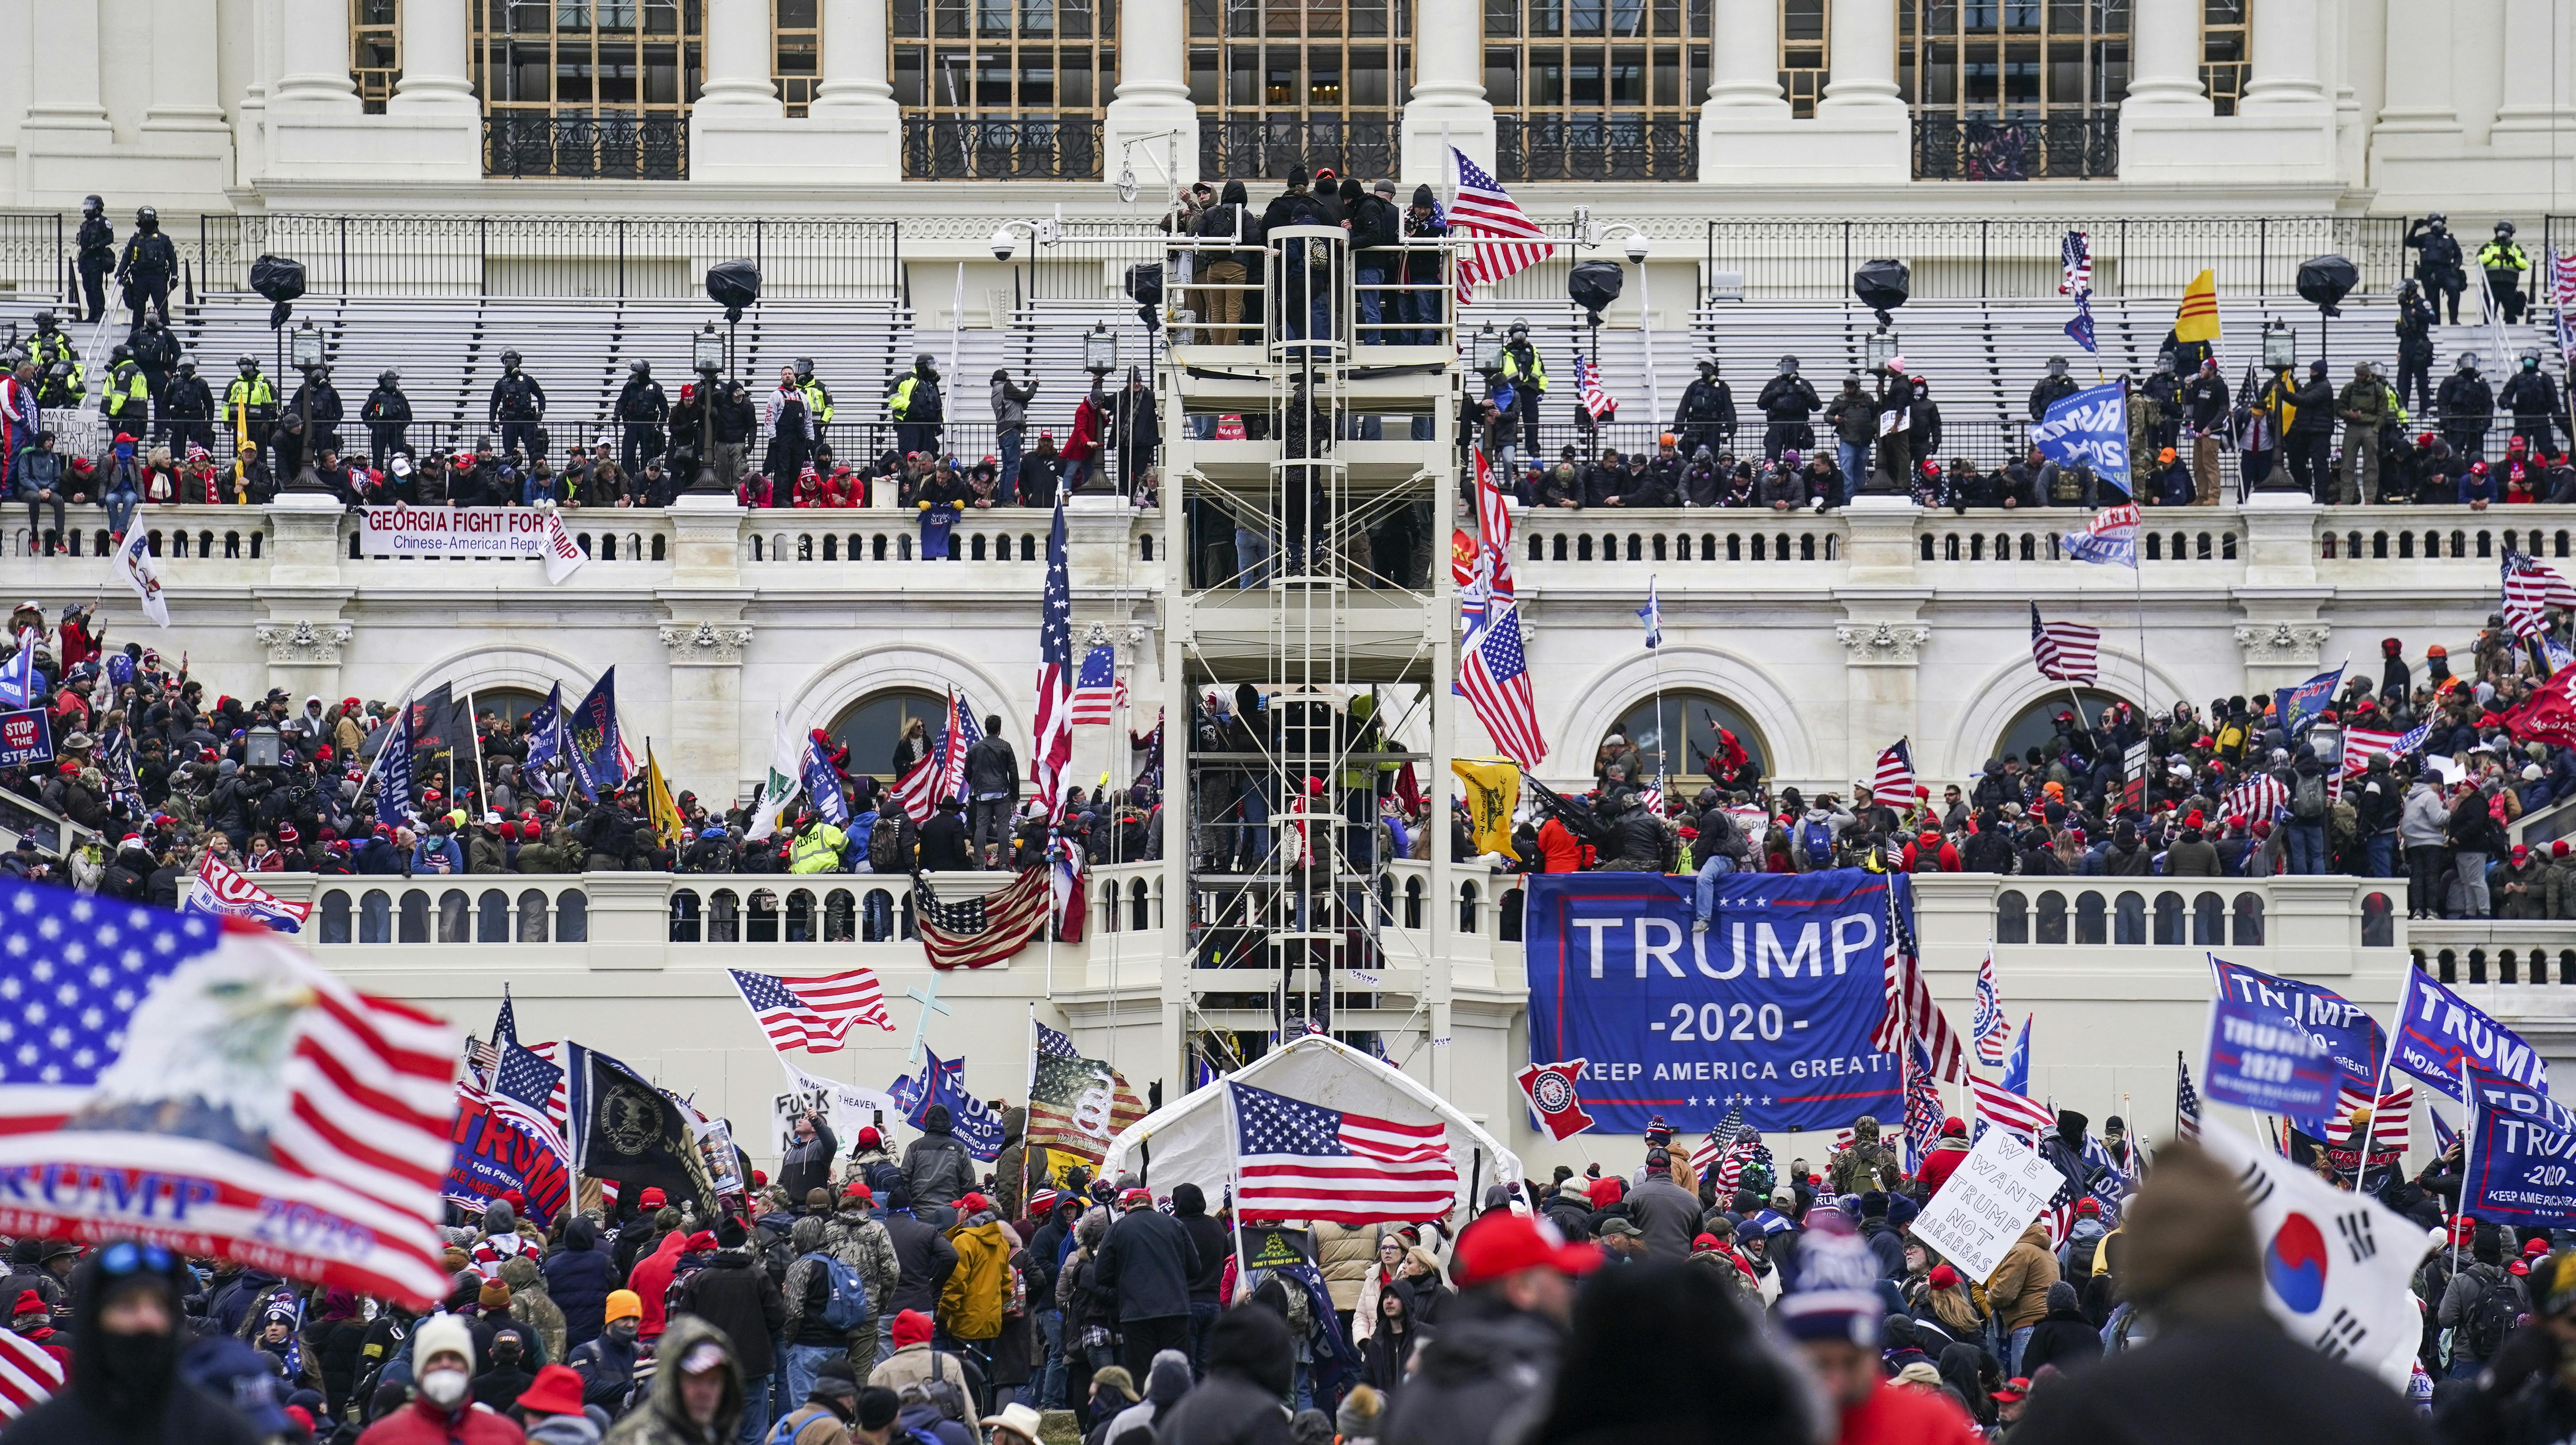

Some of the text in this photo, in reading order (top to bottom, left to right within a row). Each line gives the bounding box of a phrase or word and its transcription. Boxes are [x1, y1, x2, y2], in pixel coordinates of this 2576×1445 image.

[41, 411, 76, 421] MAKE
[1882, 407, 1907, 423] BIDN
[370, 511, 579, 560] GEORGIA FIGHT FOR RUMP
[393, 536, 507, 550] Chinese-American
[5, 720, 34, 737] STOP
[11, 736, 34, 746] THE
[1, 747, 48, 763] STEAL
[563, 729, 594, 789] AMERICA GREAT
[389, 722, 409, 818] TRUMP
[1480, 811, 1486, 823] ON
[1752, 821, 1768, 832] DIA
[202, 854, 305, 916] RUP
[201, 891, 210, 906] NO
[210, 899, 235, 916] MORE
[1572, 913, 1878, 980] TRUMP
[1352, 970, 1378, 983] TRUMP
[1353, 975, 1374, 984] PENCE
[1650, 1002, 1809, 1040] -2020-
[2283, 1017, 2338, 1049] 20-
[2222, 1013, 2331, 1059] TRUMP
[2419, 982, 2549, 1091] TRUMP
[1576, 1053, 1893, 1081] KEEP AMERICA GREAT!
[2240, 1051, 2294, 1085] 2020
[2335, 1056, 2370, 1079] GREAT!
[2403, 1046, 2427, 1070] NO
[777, 1089, 830, 1114] FUCK
[844, 1097, 876, 1109] HEAVEN
[942, 1066, 1005, 1126] TUM
[951, 1125, 986, 1151] AMERICA
[958, 1111, 1001, 1138] -20-
[1998, 1136, 2045, 1180] WE
[2328, 1148, 2401, 1170] TRUMP
[448, 1169, 506, 1200] KE AMERI
[472, 1163, 524, 1193] FOR PRESI
[1971, 1153, 2046, 1213] WANT
[2523, 1166, 2575, 1186] -2020-
[0, 1166, 216, 1220] RUMP
[1813, 1196, 1839, 1207] RUM
[1949, 1173, 2021, 1234] TRUMP
[2488, 1190, 2576, 1208] KEEP AMERICA GRE
[0, 1210, 60, 1232] EEP
[255, 1198, 375, 1257] 2020
[1946, 1208, 1995, 1246] NOT
[1916, 1210, 1992, 1273] BARABBAS
